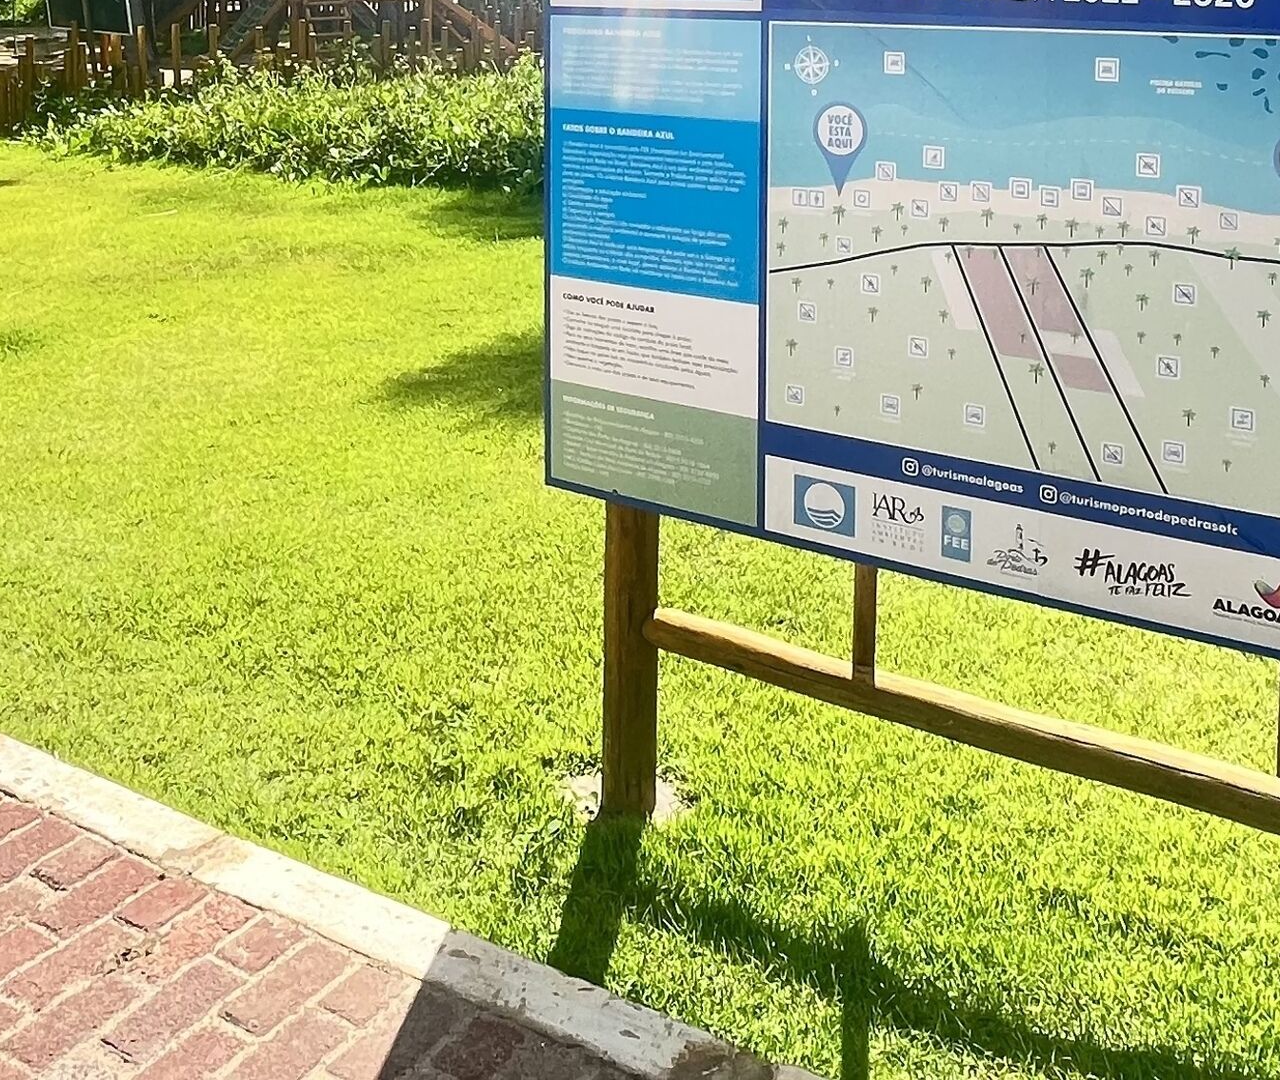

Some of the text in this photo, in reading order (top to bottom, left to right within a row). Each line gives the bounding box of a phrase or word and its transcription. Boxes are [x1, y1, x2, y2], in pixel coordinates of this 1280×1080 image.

[828, 113, 853, 125] VOCÊ
[828, 138, 852, 149] AQUI
[562, 292, 584, 302] COMO
[921, 464, 1024, 492] @turismoalagoas
[1059, 491, 1238, 535] @turismoportodepedrasofc
[944, 535, 969, 551] FEE
